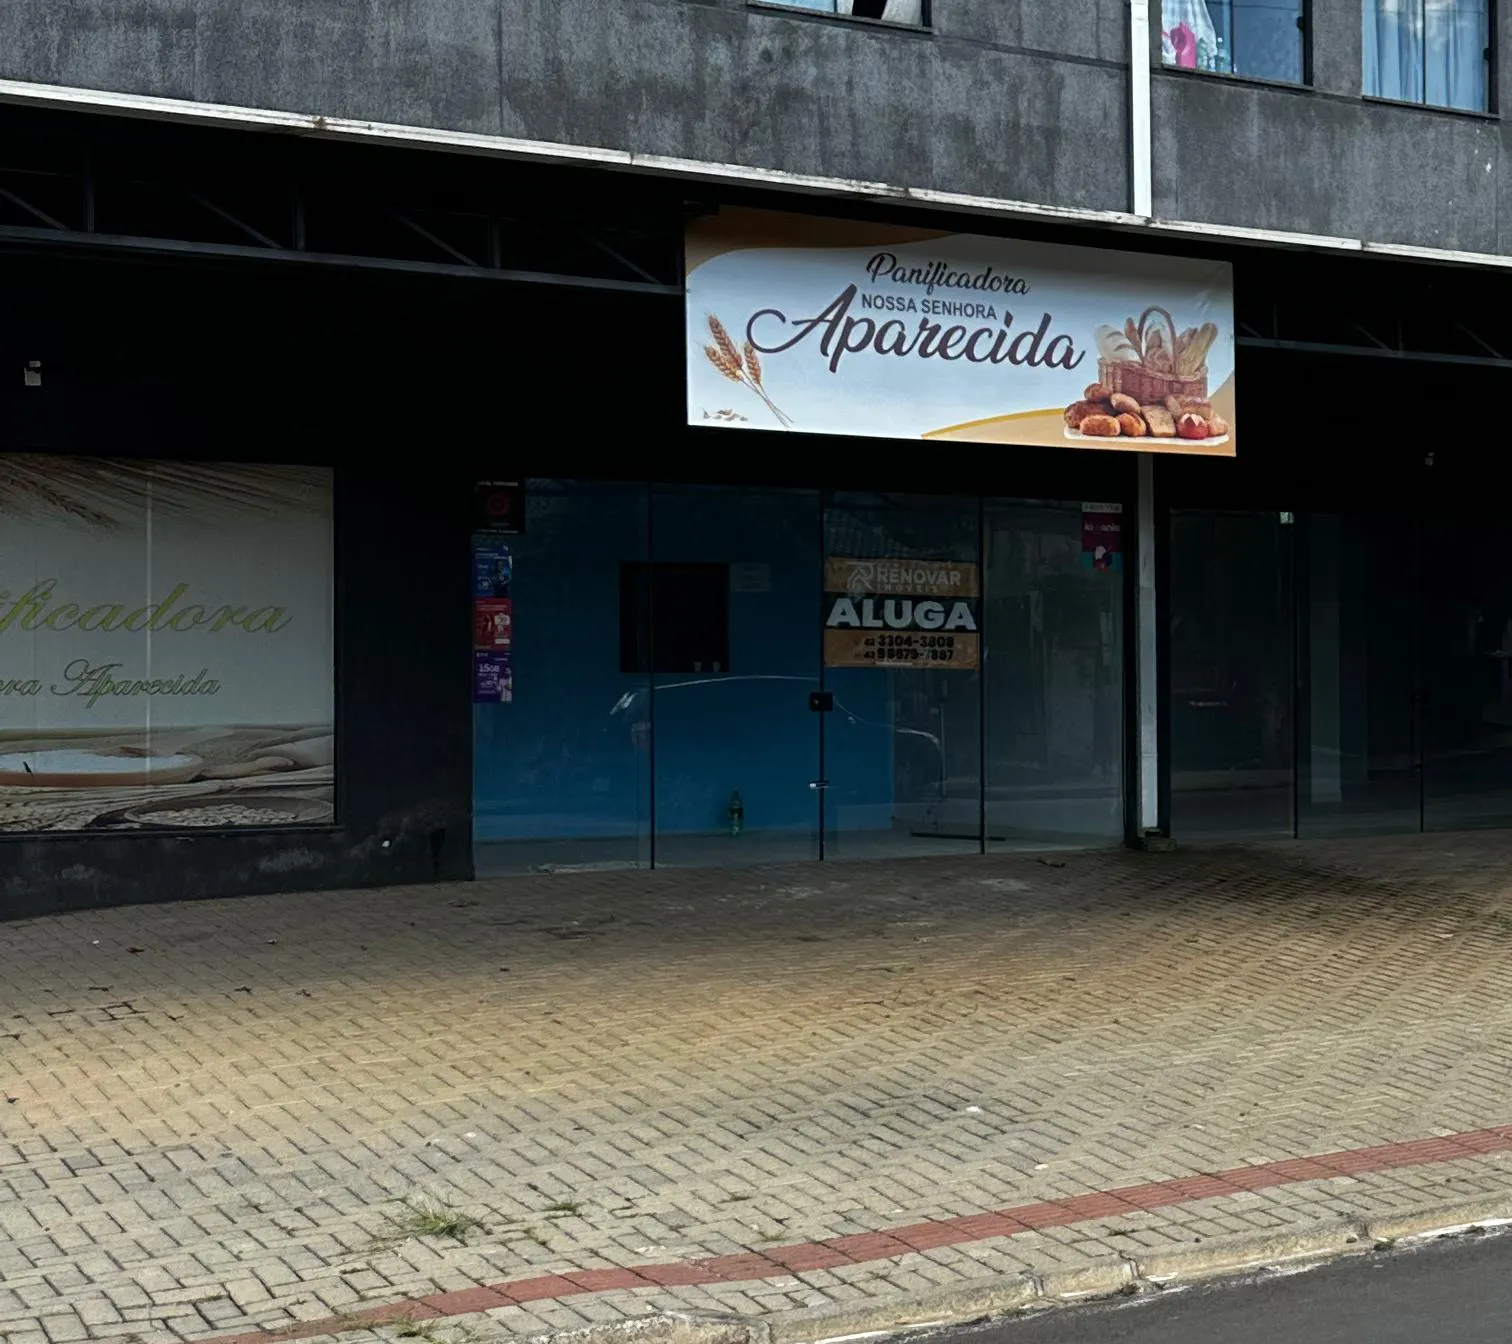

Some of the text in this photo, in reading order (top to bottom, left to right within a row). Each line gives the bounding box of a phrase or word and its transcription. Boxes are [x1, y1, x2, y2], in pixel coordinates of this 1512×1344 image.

[865, 252, 1031, 297] Panificadora
[861, 293, 997, 321] NOSSA SENHORA
[745, 283, 1086, 373] Aparecida
[876, 567, 961, 586] RENOVAR
[825, 597, 977, 631] ALUGA
[50, 659, 222, 709] Aparecida
